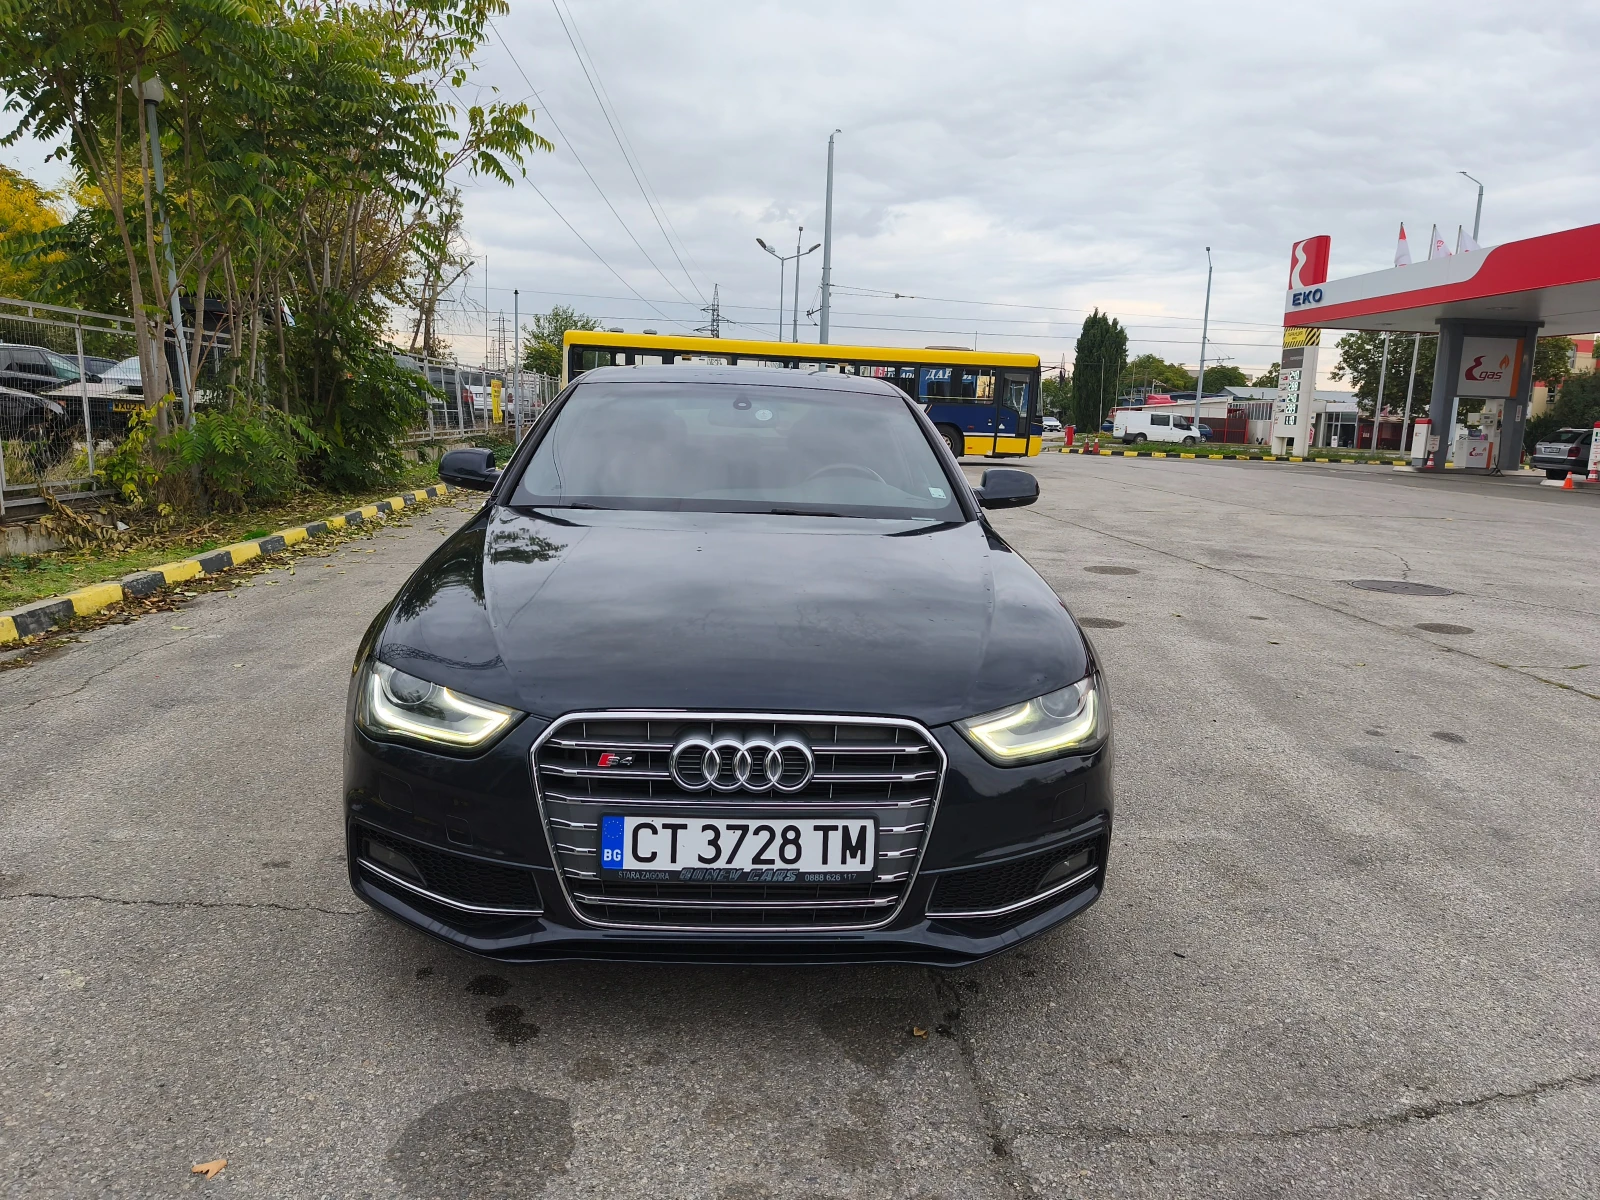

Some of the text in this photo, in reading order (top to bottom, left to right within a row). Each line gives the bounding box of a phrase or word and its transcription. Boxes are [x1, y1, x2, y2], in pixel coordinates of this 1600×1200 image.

[1292, 288, 1323, 306] EKO
[631, 822, 868, 866] CT 3728 TM
[603, 848, 622, 861] BG
[618, 871, 640, 879] STARA
[641, 872, 670, 880] ZAGORA
[746, 868, 800, 882] CARS
[804, 873, 824, 882] 0888
[826, 873, 841, 882] 626
[843, 873, 857, 881] 117
